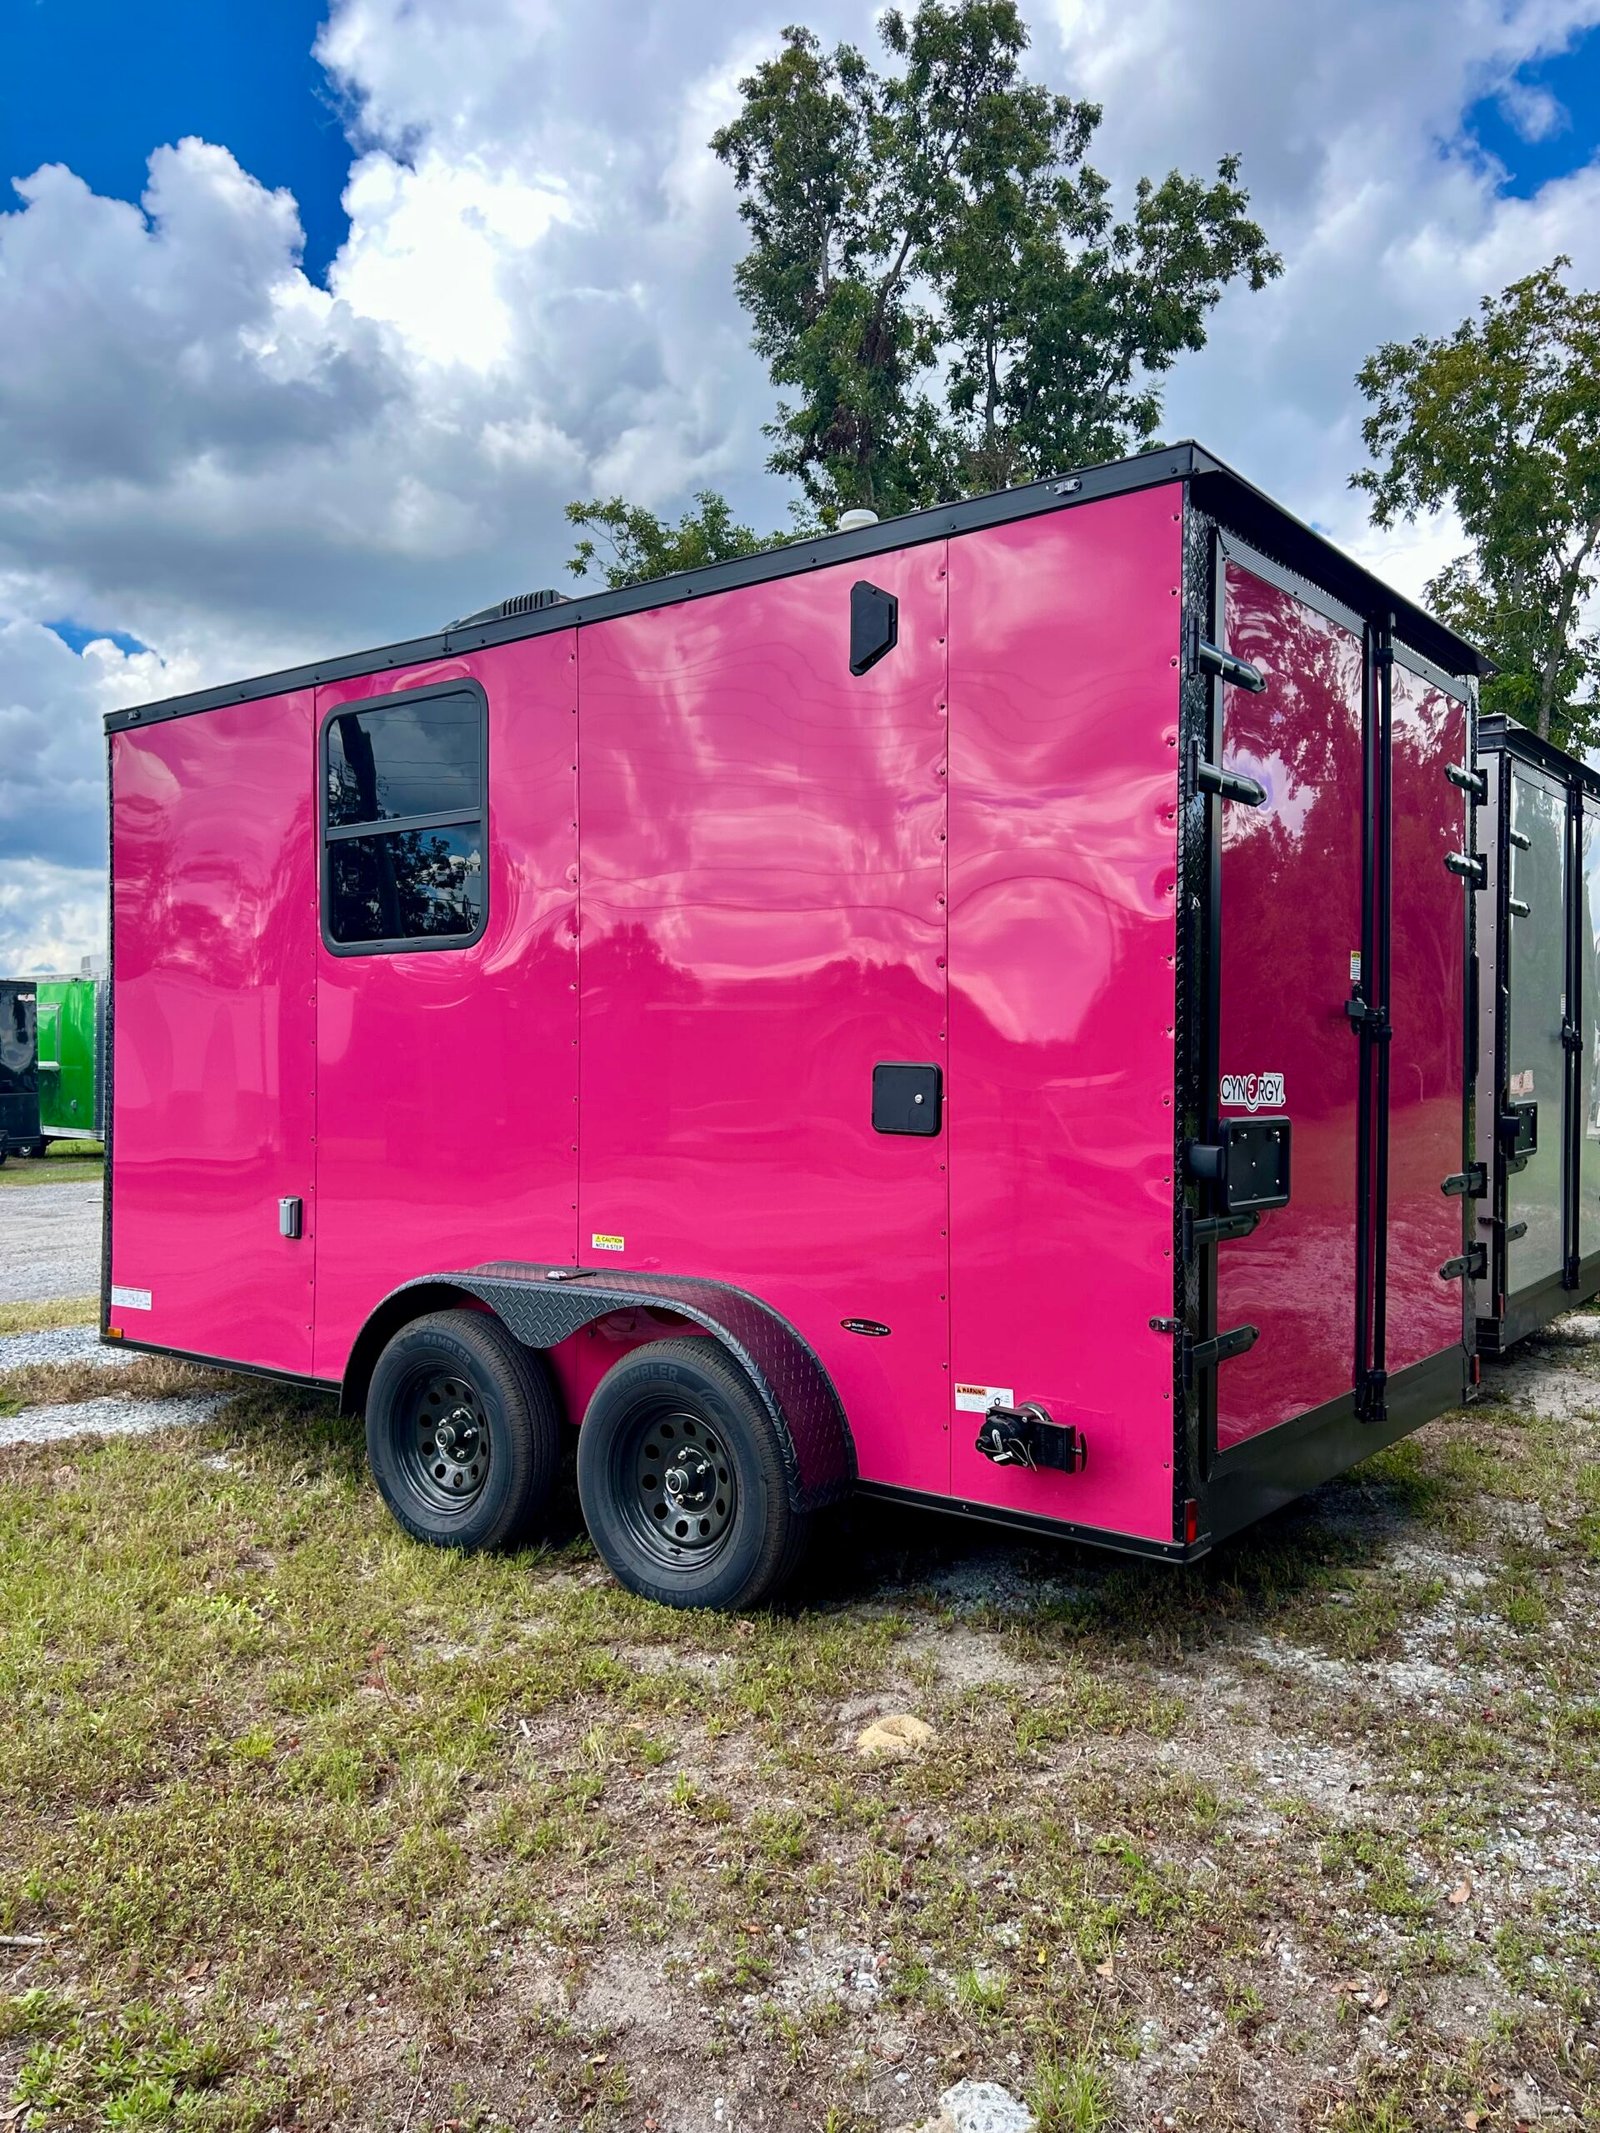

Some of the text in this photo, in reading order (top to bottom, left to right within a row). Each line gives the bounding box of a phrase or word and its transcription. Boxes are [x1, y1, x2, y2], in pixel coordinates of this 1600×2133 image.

[1222, 1075, 1281, 1105] CYNERGY
[423, 1334, 472, 1366] RAMBLER
[612, 1364, 679, 1394] RAMBLER
[962, 1387, 986, 1396] WARNING
